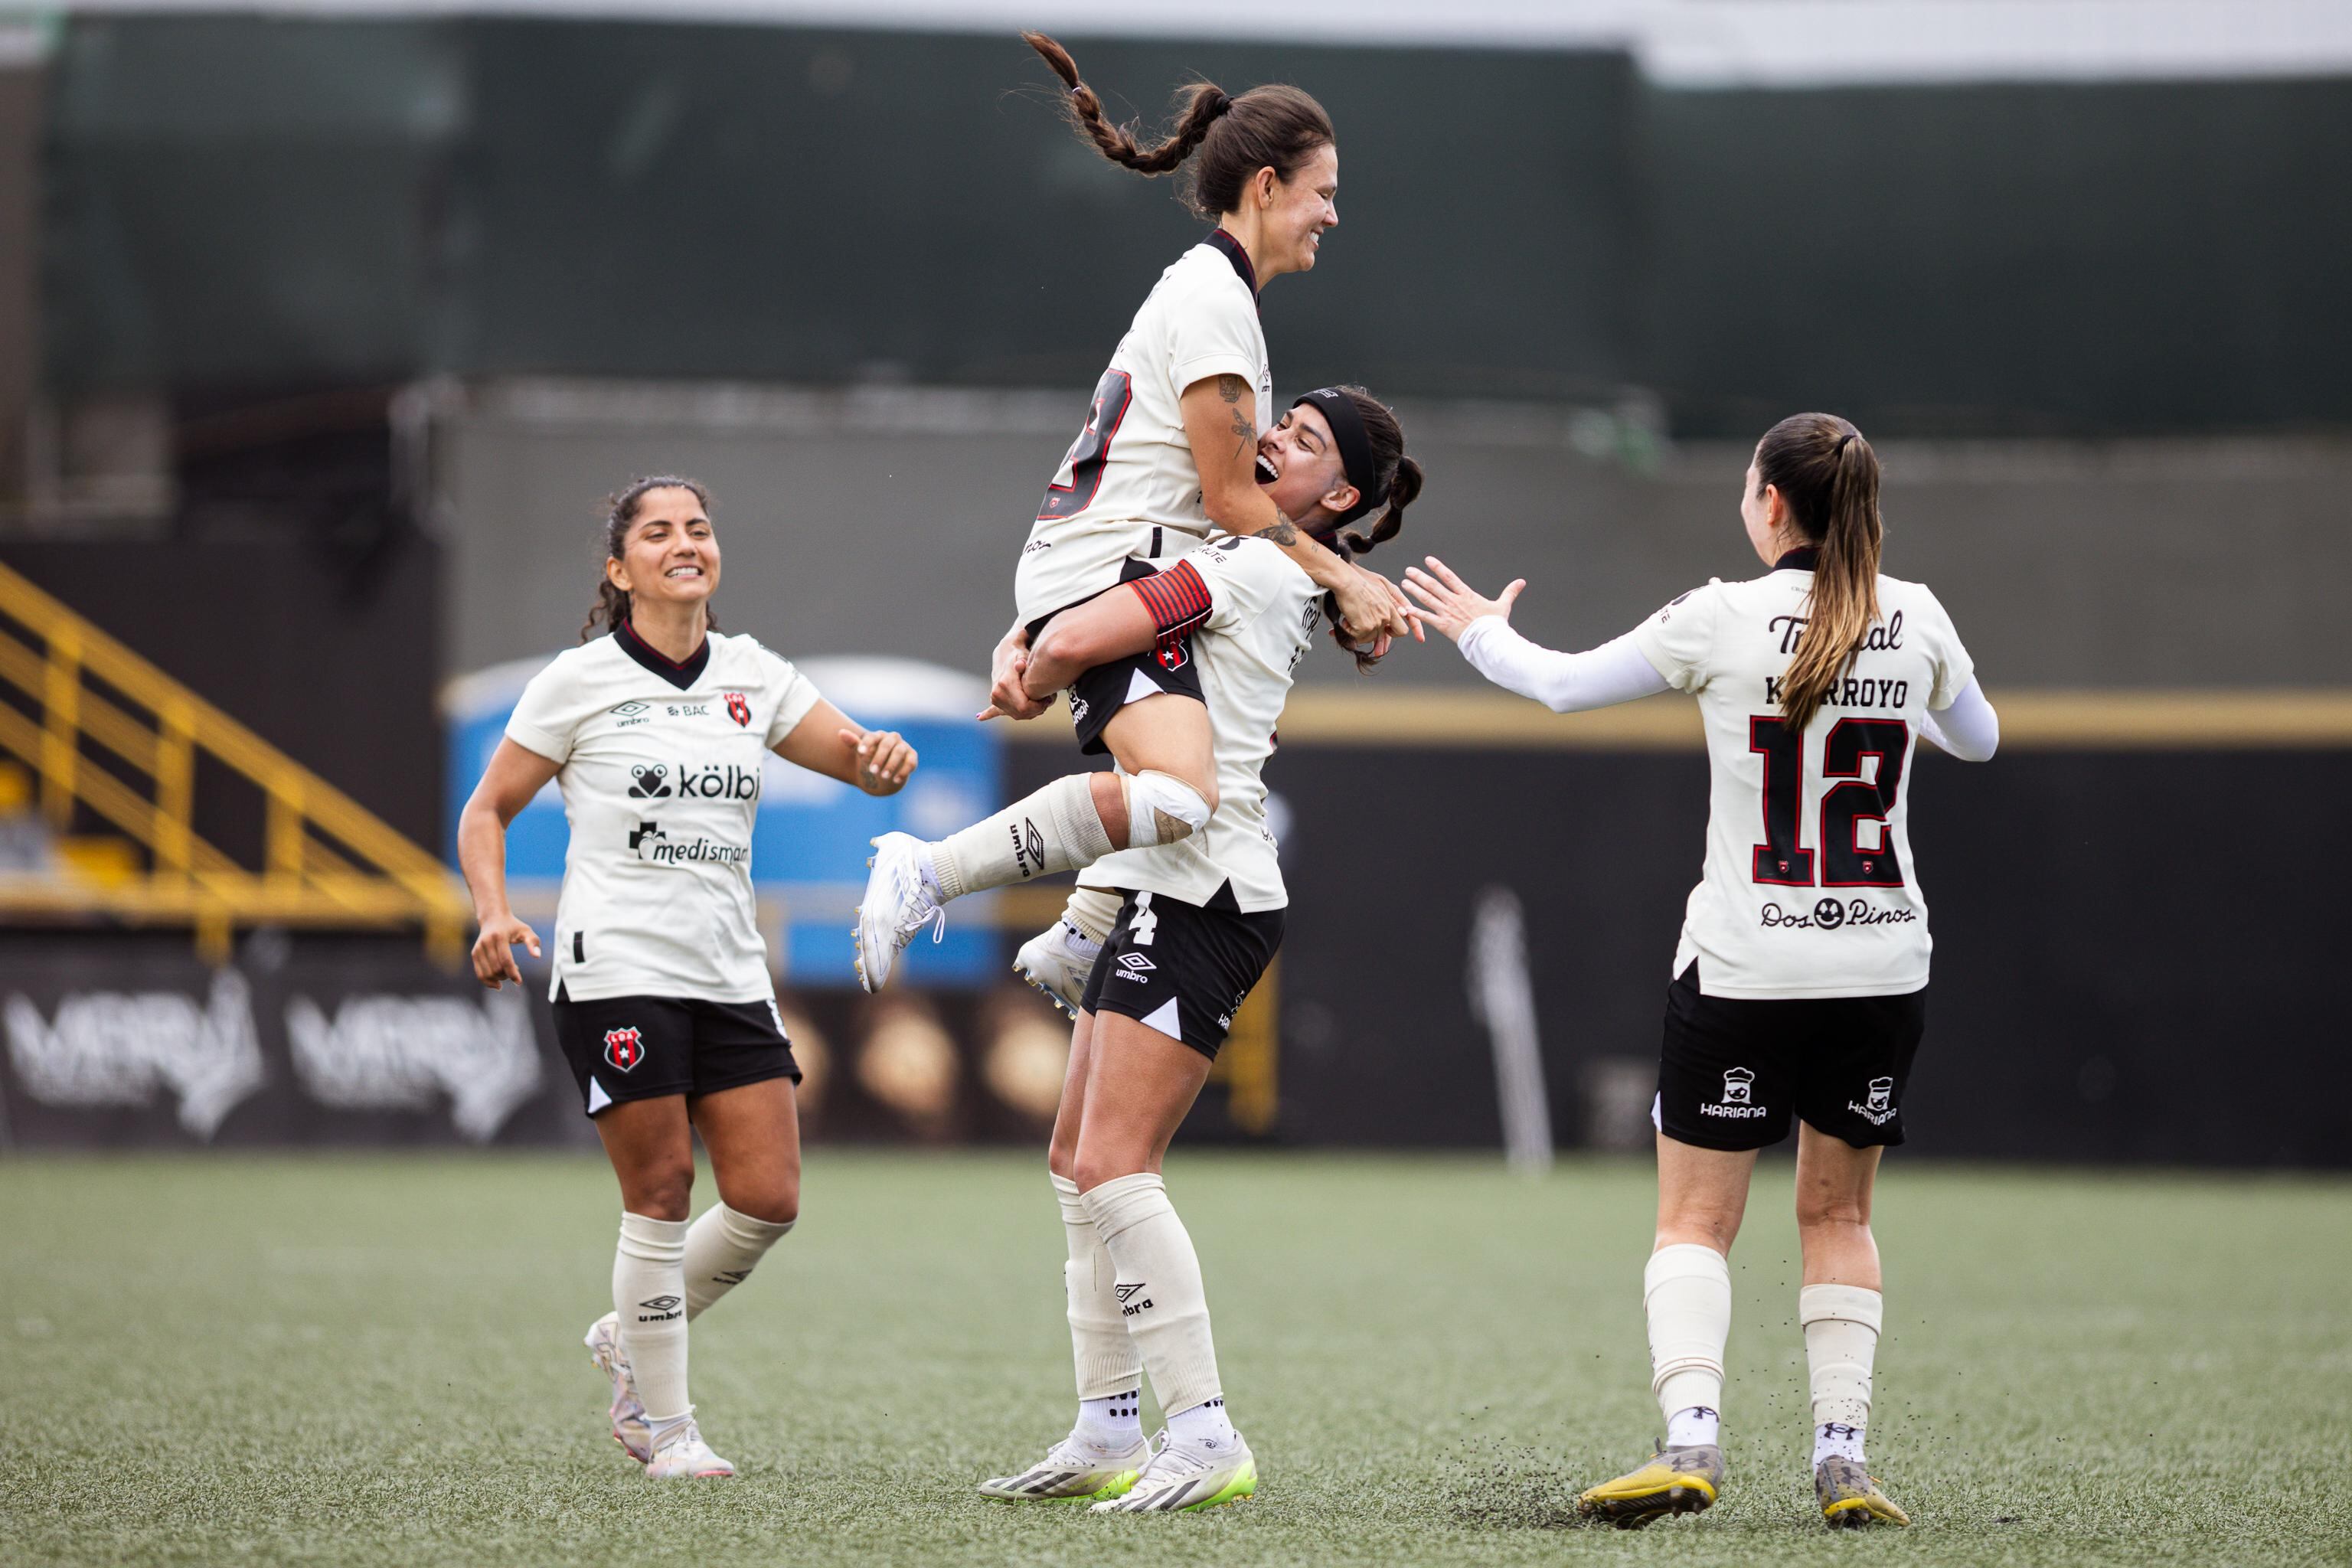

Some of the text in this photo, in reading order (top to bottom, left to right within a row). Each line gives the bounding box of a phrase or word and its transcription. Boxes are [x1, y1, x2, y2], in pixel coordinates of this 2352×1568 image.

[1769, 609, 1903, 654] Tral
[1819, 677, 1908, 708] RROYO
[616, 717, 649, 728] umbro
[683, 705, 710, 716] BAC
[678, 764, 760, 801] kölbi
[1749, 714, 1909, 887] 12
[653, 838, 749, 865] medismar
[1010, 824, 1031, 877] umbro
[1761, 898, 1917, 929] Dos Pinos
[1116, 969, 1148, 984] umbro
[1700, 1102, 1767, 1119] HARIANA
[1847, 1100, 1897, 1125] HARIANA
